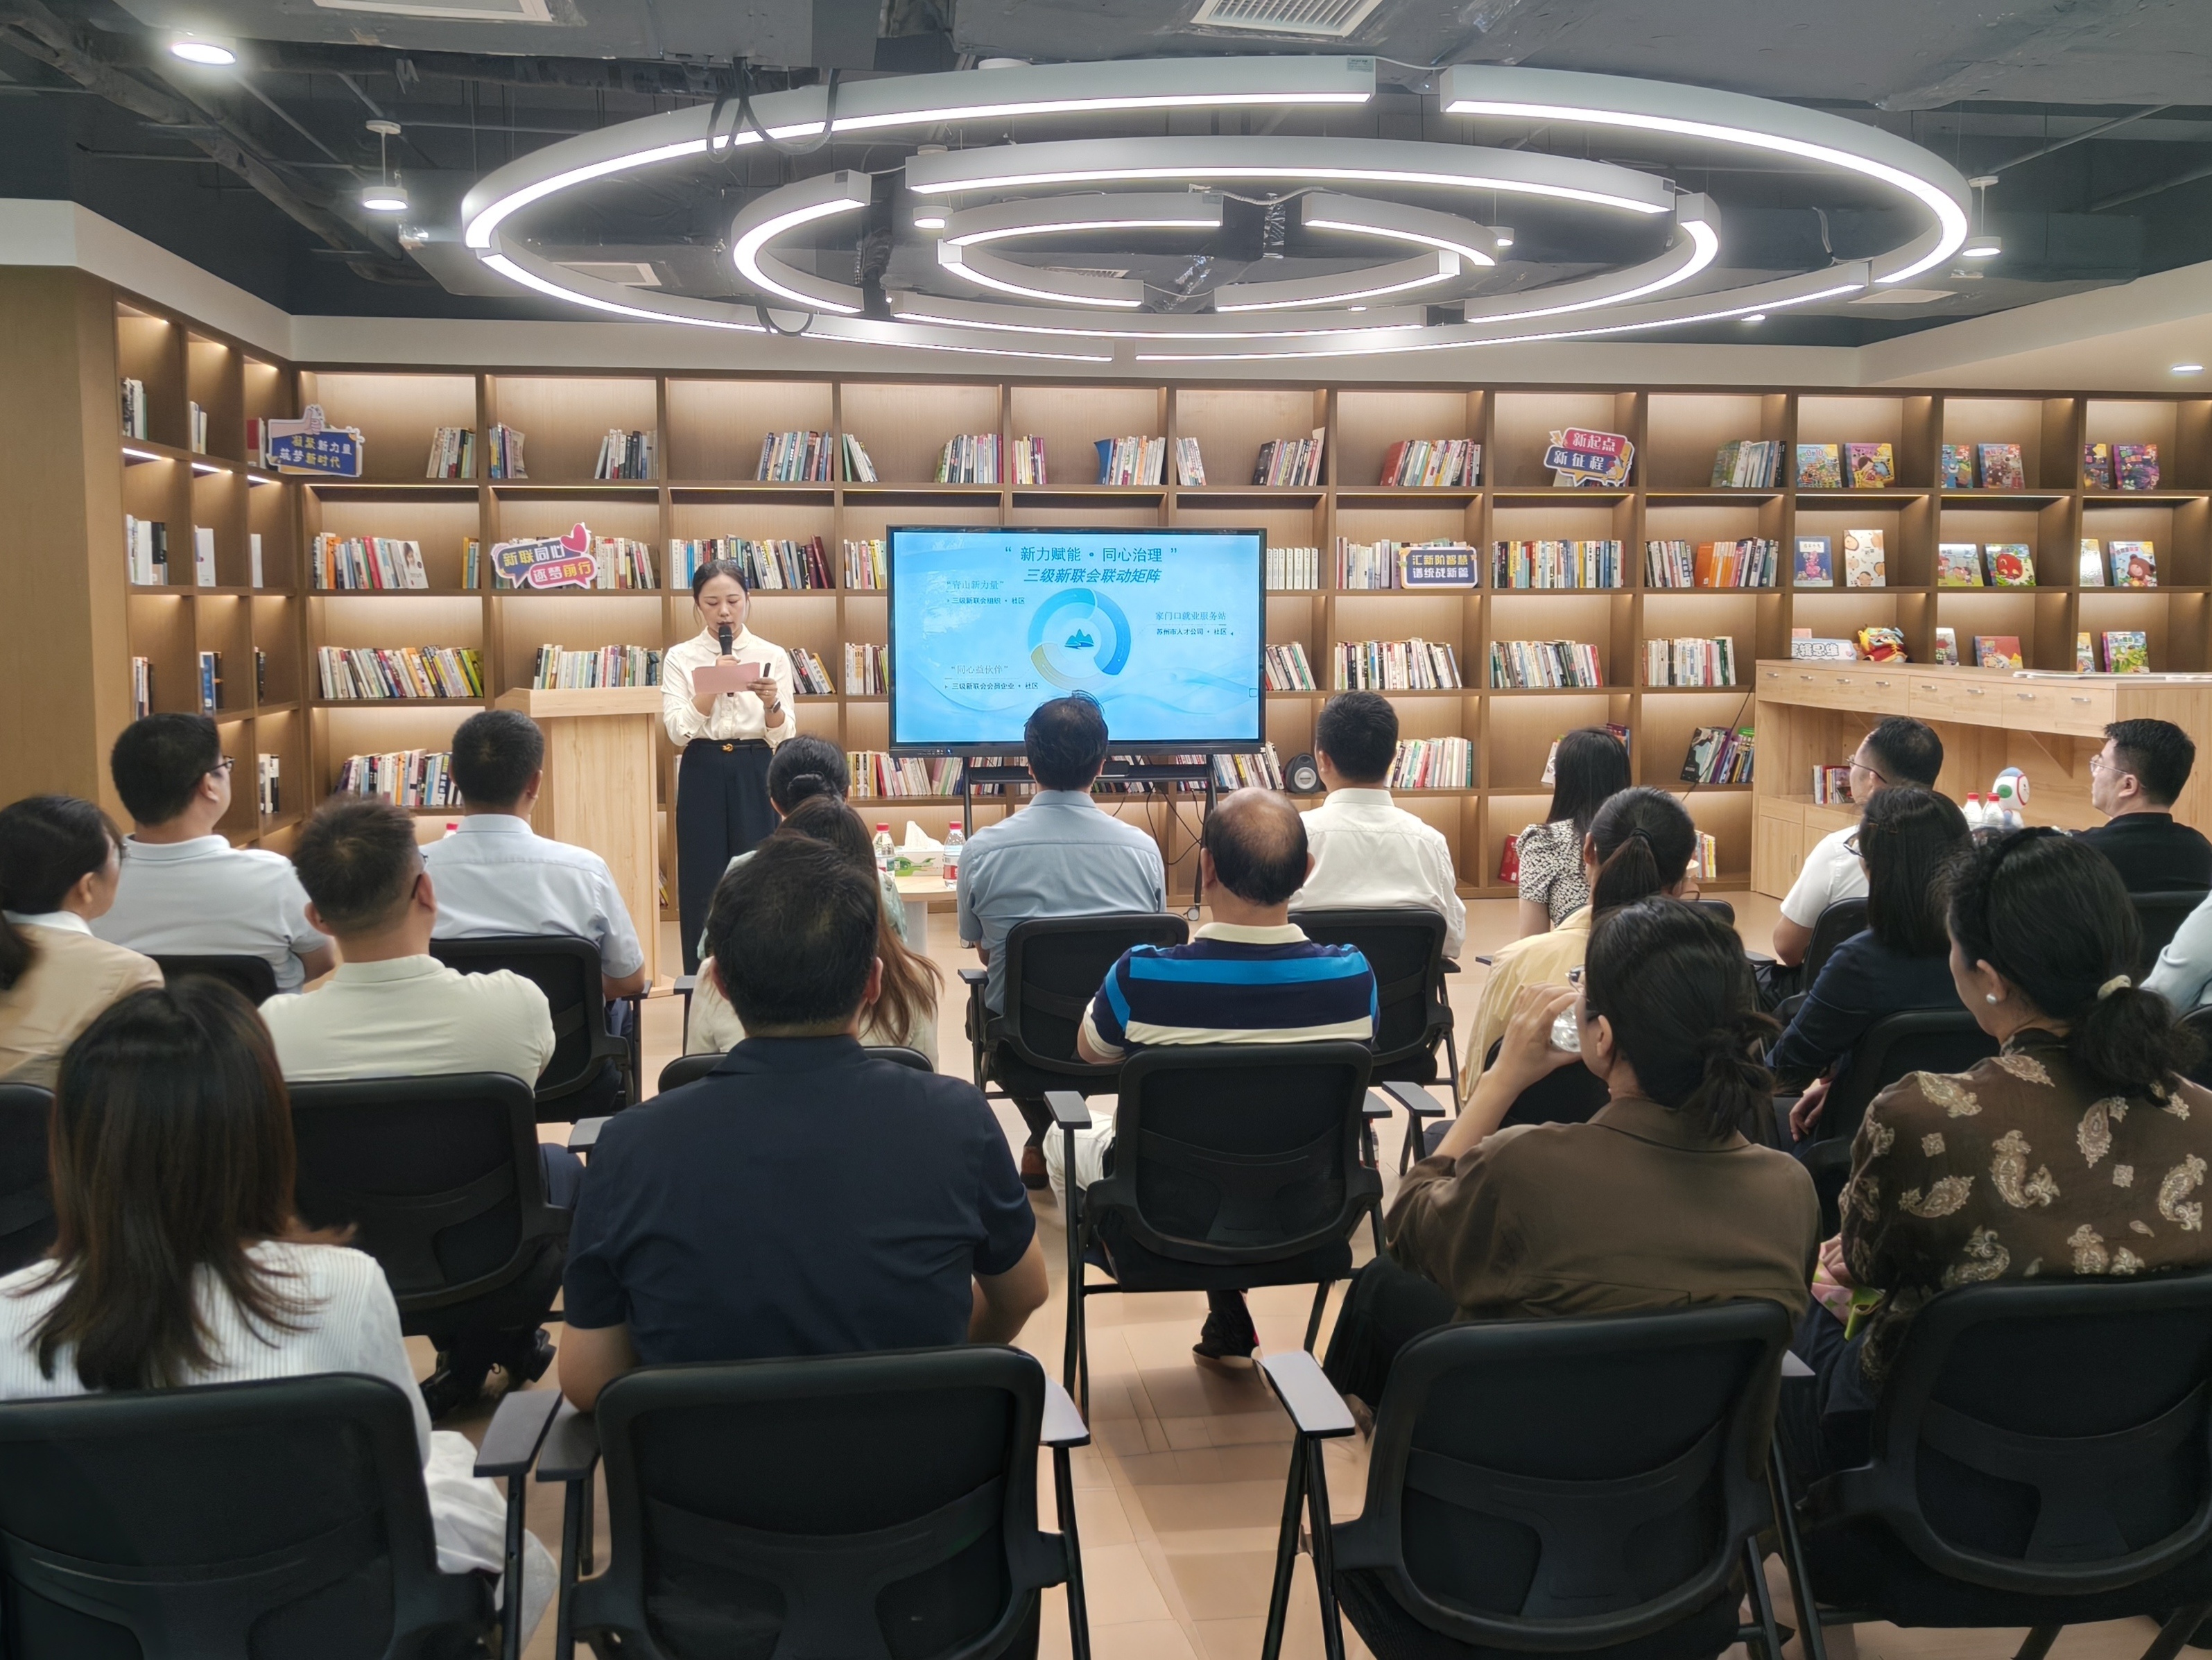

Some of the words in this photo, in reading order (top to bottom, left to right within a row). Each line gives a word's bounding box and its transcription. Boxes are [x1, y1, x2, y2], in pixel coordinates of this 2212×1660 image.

[291, 435, 352, 455] 凝聚新力量
[1572, 432, 1616, 452] 新起点
[279, 447, 341, 469] 筑梦新时代
[1553, 450, 1605, 471] 新征程
[502, 544, 566, 567] 新联同心
[1412, 554, 1469, 565] 汇新阶智慧
[532, 561, 591, 582] 逐梦前行
[1023, 568, 1163, 584] 三级新联会联动矩阵
[1412, 567, 1469, 578] 谱统战新篇
[1155, 611, 1227, 621] 家门口就业服务站
